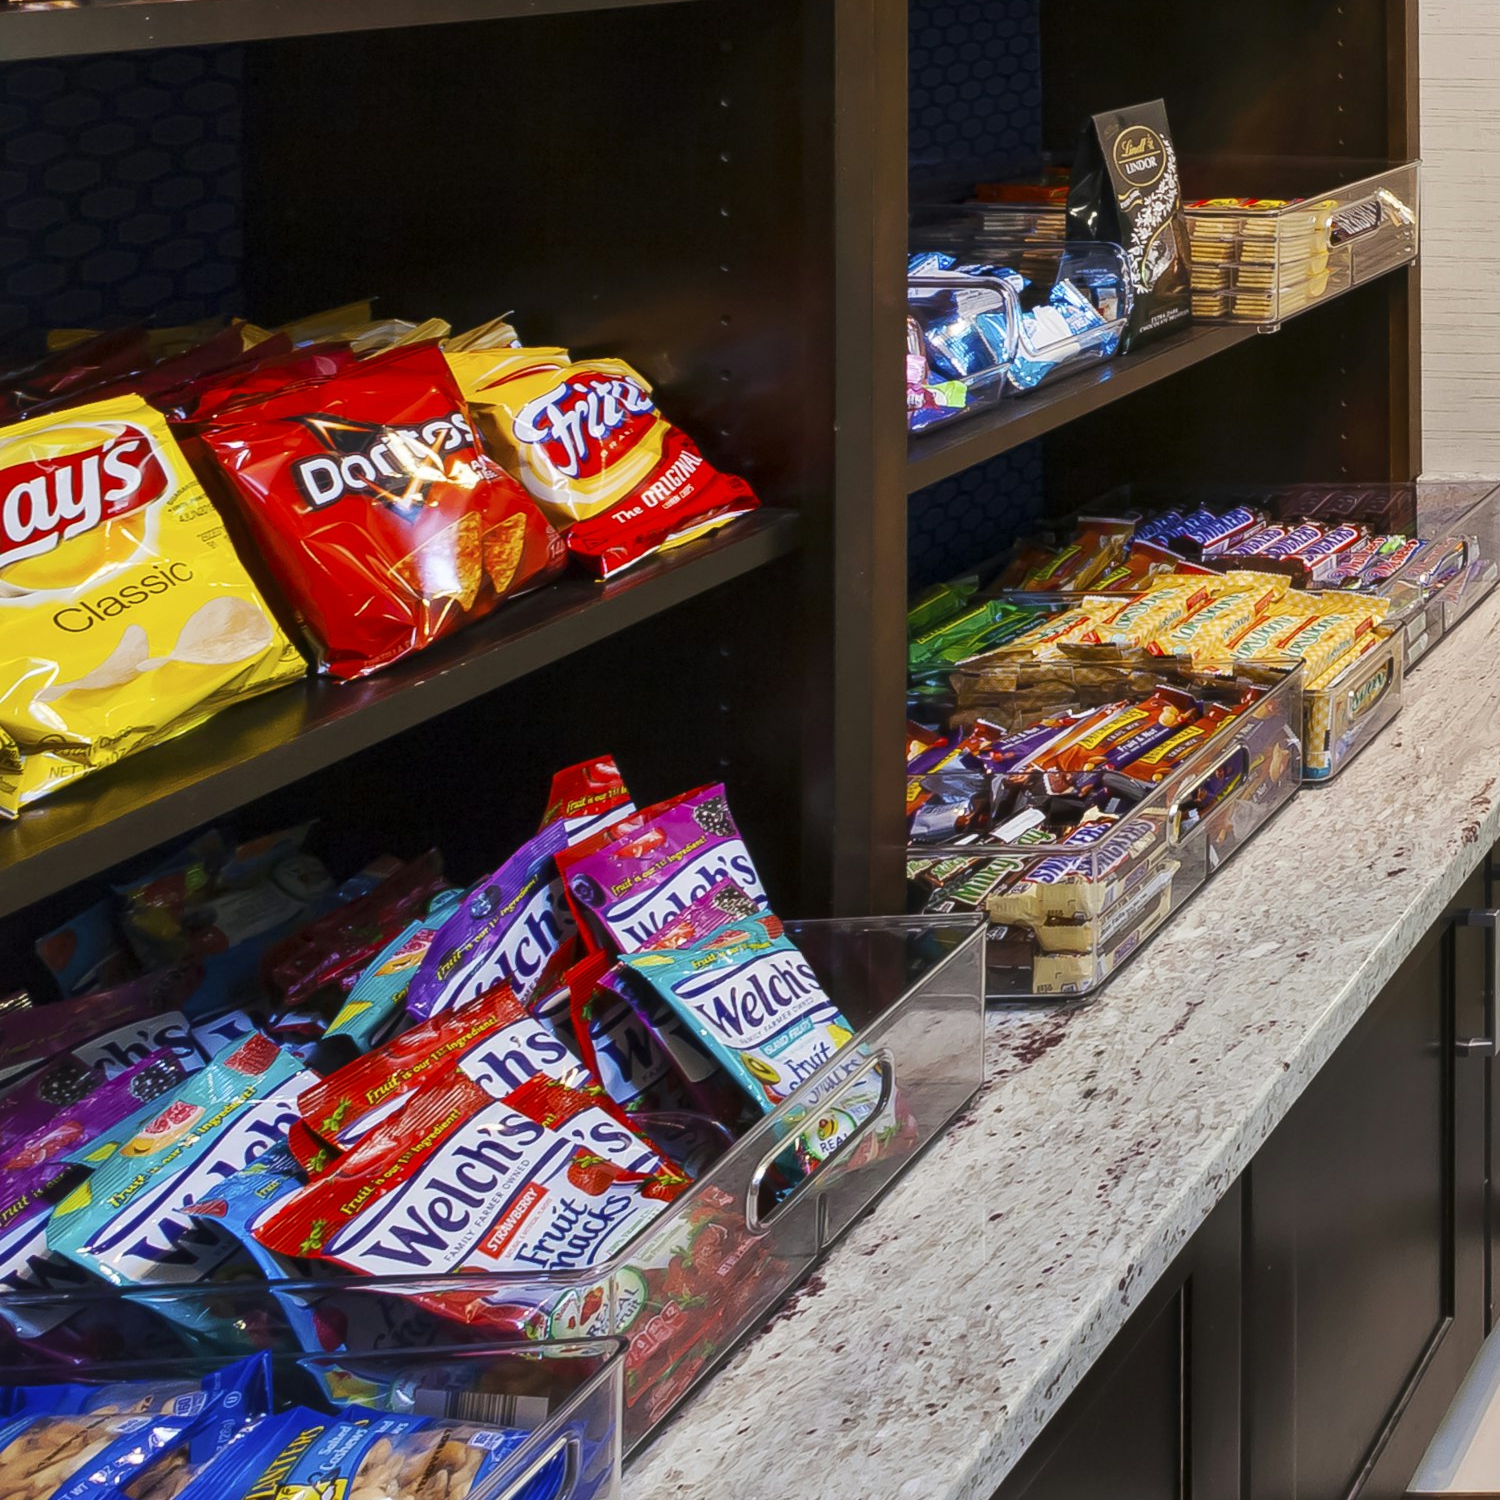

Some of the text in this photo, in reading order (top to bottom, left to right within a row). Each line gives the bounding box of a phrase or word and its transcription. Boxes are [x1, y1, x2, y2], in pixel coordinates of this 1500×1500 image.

[1125, 156, 1159, 175] LINDOR
[300, 412, 482, 505] Doritos
[640, 450, 703, 509] ORIGINAL
[612, 505, 643, 524] The
[53, 560, 193, 633] Classic
[1117, 737, 1137, 753] Fruit
[697, 958, 823, 1043] Welch's
[364, 1014, 498, 1105] Fruit our Ingredient!
[107, 1148, 183, 1209] Fruit our
[339, 1108, 461, 1215] Fruit our Ingredient!
[358, 1111, 547, 1268] Welch's
[442, 1228, 477, 1263] FAMILY
[476, 1189, 506, 1229] FARMER
[502, 1157, 531, 1192] OWNED
[487, 1187, 540, 1253] STRAWBERRY
[513, 1195, 588, 1269] Fruit
[318, 1425, 349, 1458] Salted
[318, 1426, 369, 1473] Cashews
